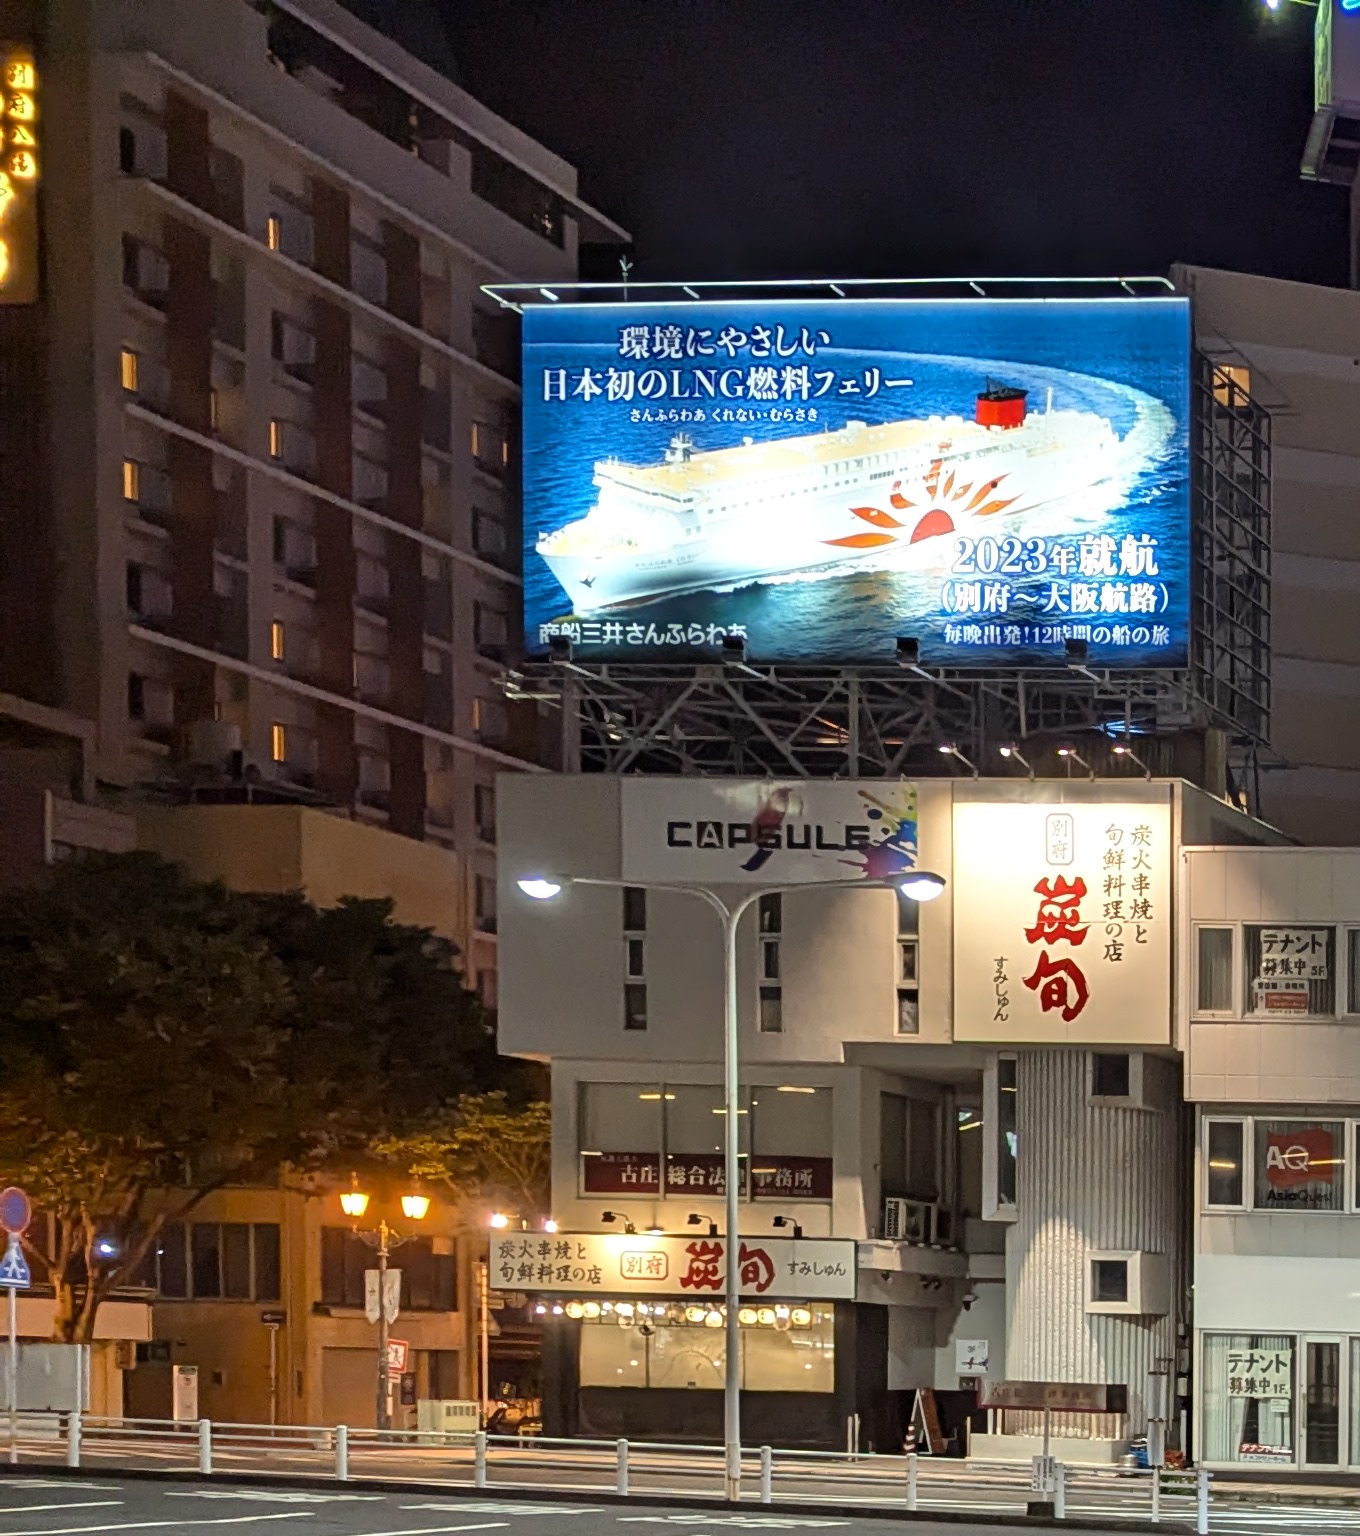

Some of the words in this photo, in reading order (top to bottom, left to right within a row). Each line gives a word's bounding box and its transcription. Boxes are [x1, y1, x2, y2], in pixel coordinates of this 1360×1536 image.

[618, 325, 830, 359] 環境にやさしい
[543, 366, 914, 401] 日本初のLNG燃料フェリー
[630, 408, 706, 422] さんふらわあ
[952, 534, 1159, 577] 2023年就航
[667, 820, 871, 851] CAPSULE
[1051, 819, 1068, 860] 別府
[1102, 823, 1126, 962] 旬鮮料理の店
[1130, 824, 1154, 944] 炭火串焼と
[1263, 933, 1323, 954] テナント
[993, 956, 1009, 1022] すみしゅん
[1266, 1145, 1309, 1172] AQ
[620, 1164, 814, 1187] 古庄総合法事務所
[498, 1239, 587, 1261] 炭火串焼と
[498, 1263, 602, 1285] 旬鮮料理の店
[625, 1255, 664, 1276] 別府
[787, 1260, 847, 1277] すみしゅん
[1228, 1352, 1288, 1374] テナント
[1229, 1377, 1270, 1394] 募集中
